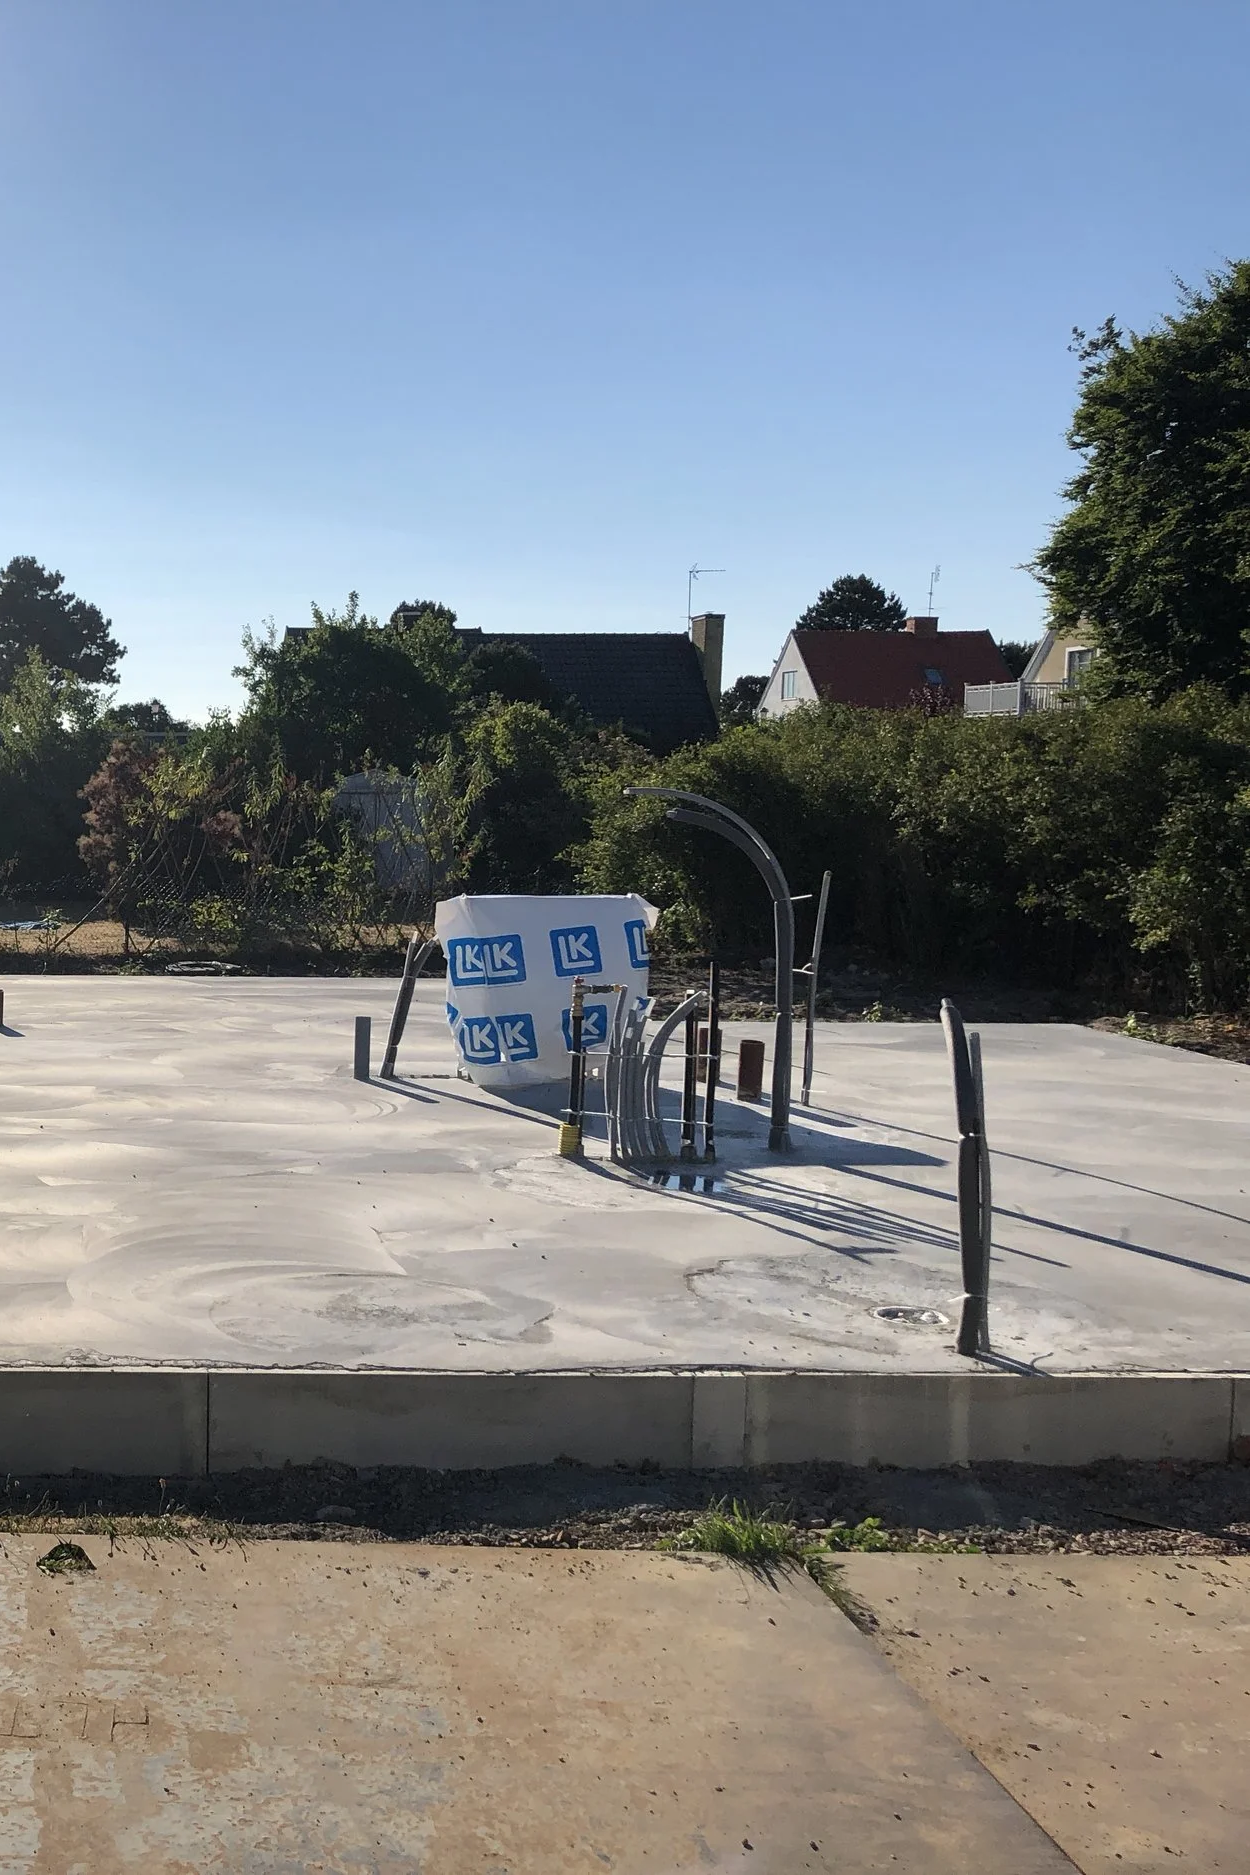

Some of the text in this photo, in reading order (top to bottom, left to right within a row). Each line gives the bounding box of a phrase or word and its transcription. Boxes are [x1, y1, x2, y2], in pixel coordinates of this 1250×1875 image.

[455, 944, 484, 979] LK
[483, 941, 519, 978] LK
[558, 932, 594, 970] LK
[633, 926, 650, 961] L
[463, 1022, 496, 1058] LK
